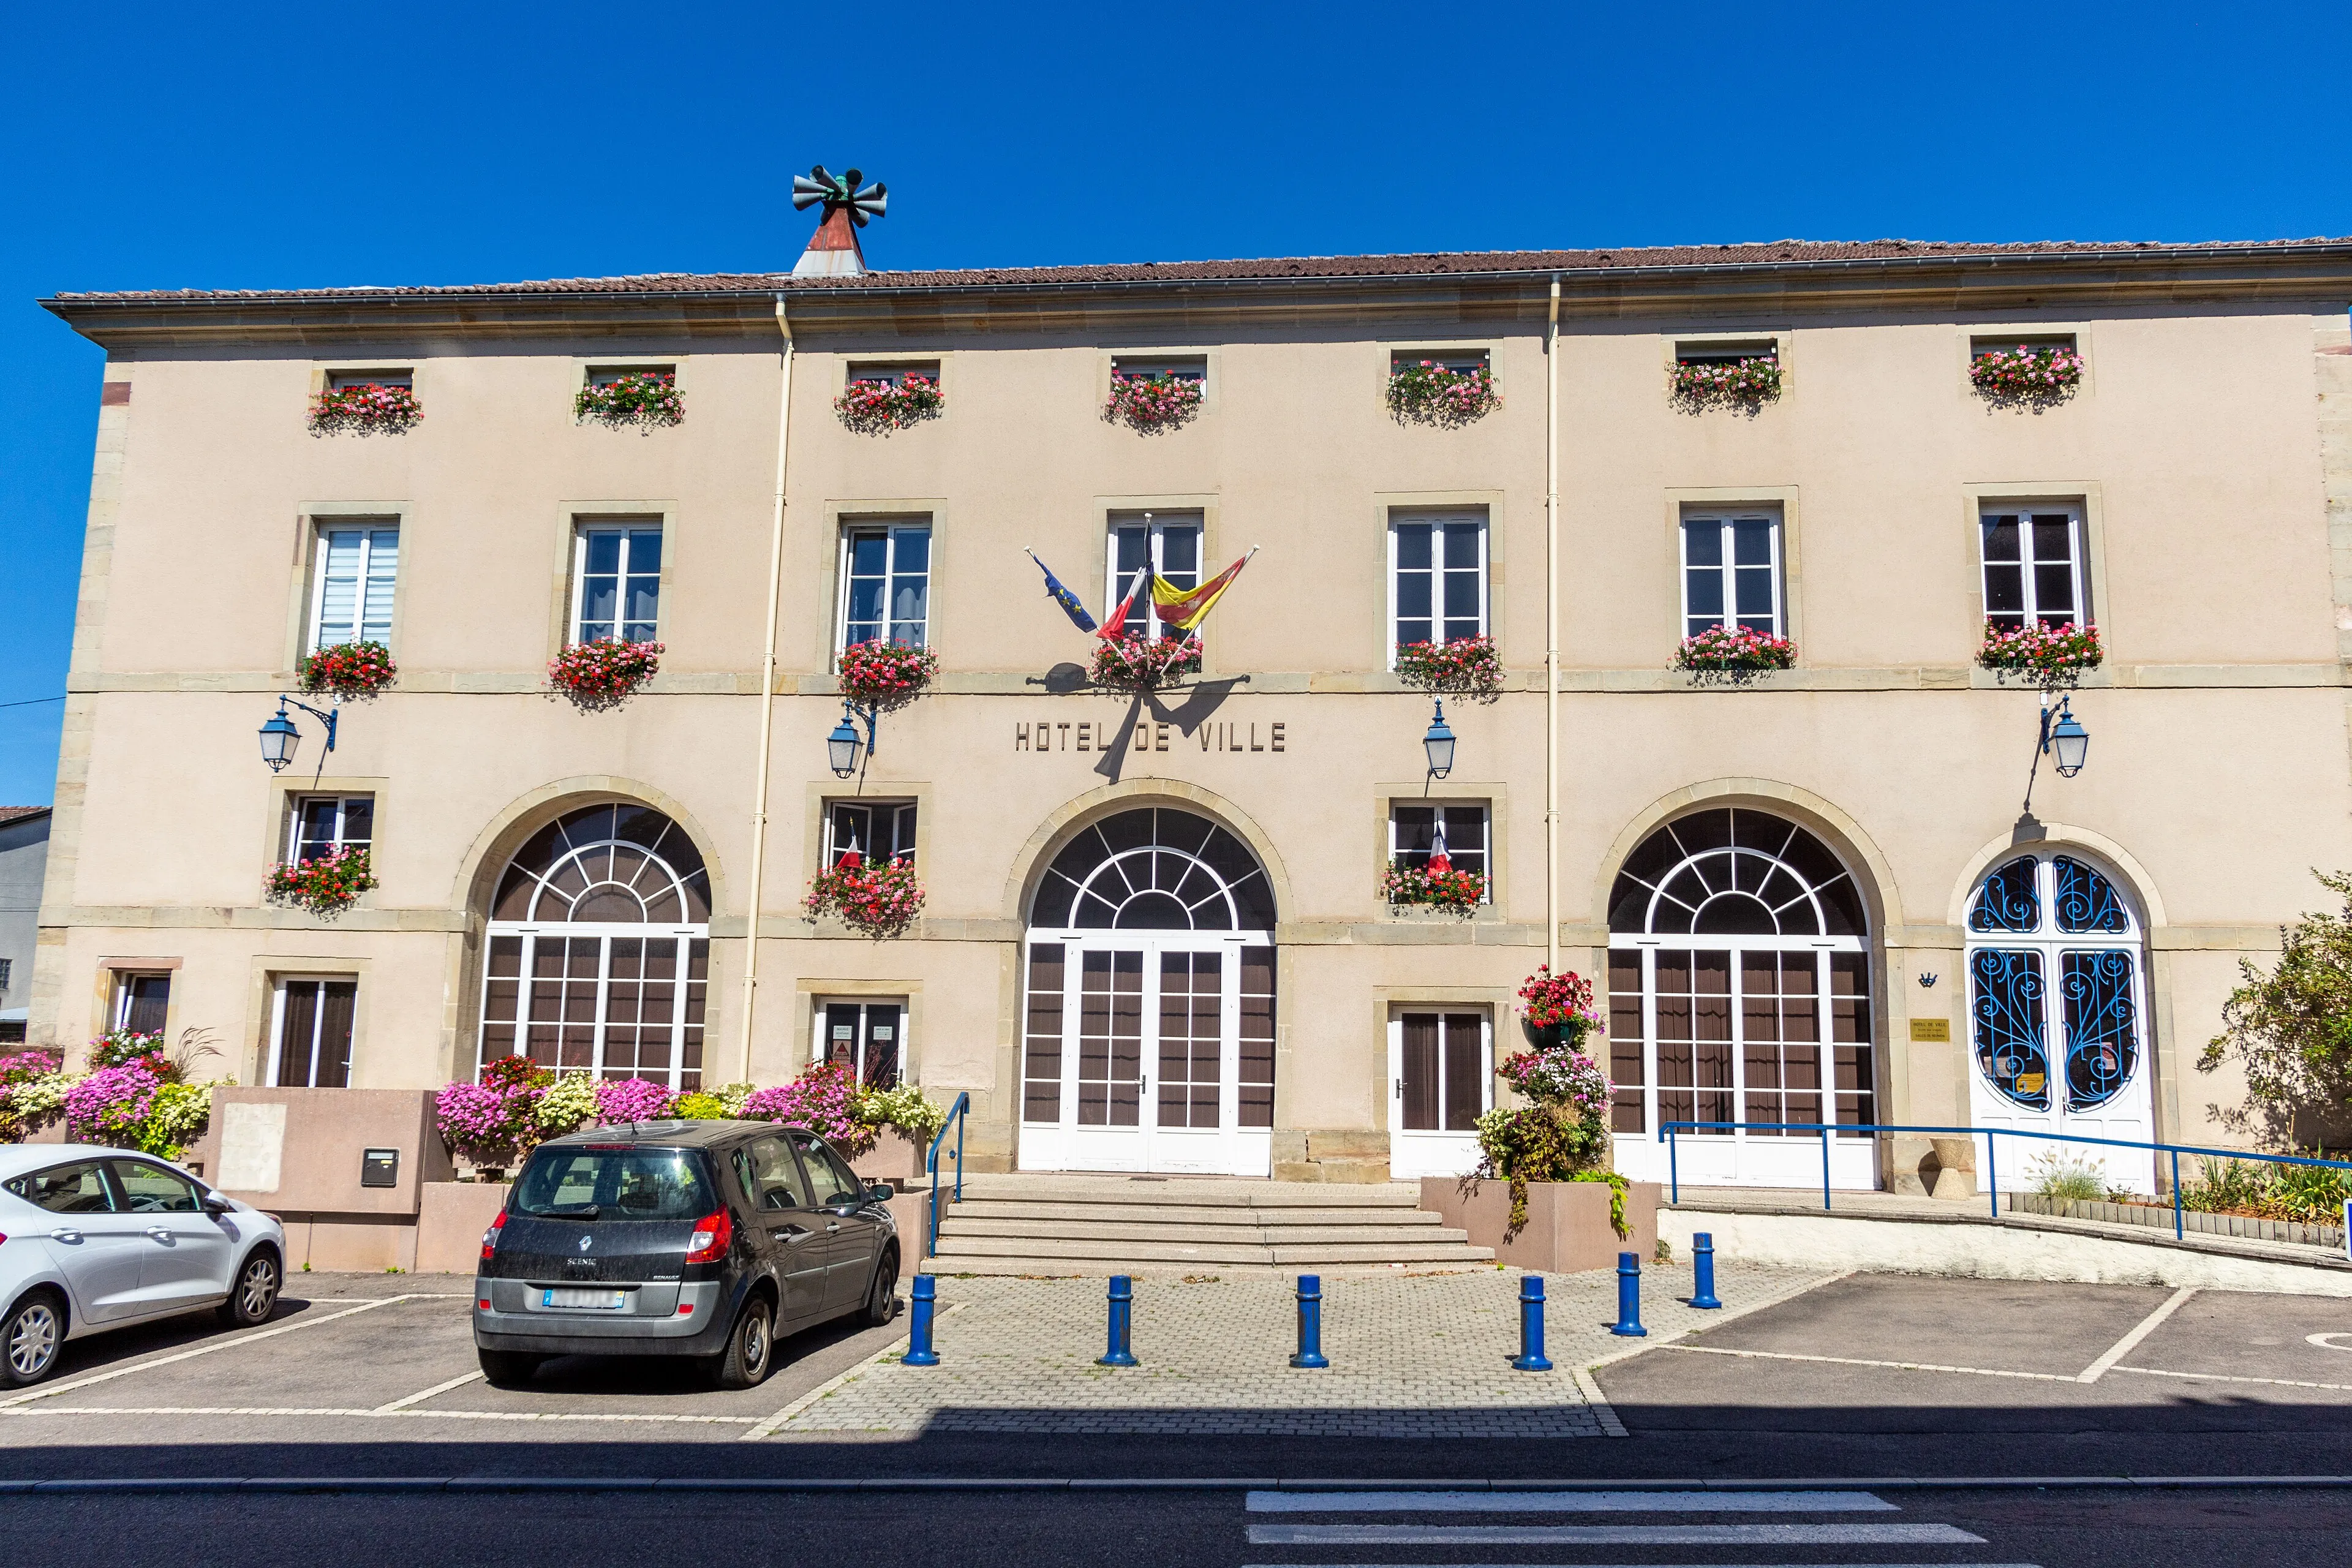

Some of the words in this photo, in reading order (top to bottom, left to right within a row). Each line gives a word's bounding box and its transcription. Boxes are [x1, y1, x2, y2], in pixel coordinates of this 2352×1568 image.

[1016, 722, 1110, 752] HOTEL
[1135, 722, 1169, 752] DE
[1199, 722, 1285, 752] VILLE
[567, 1257, 597, 1266] SCENIC
